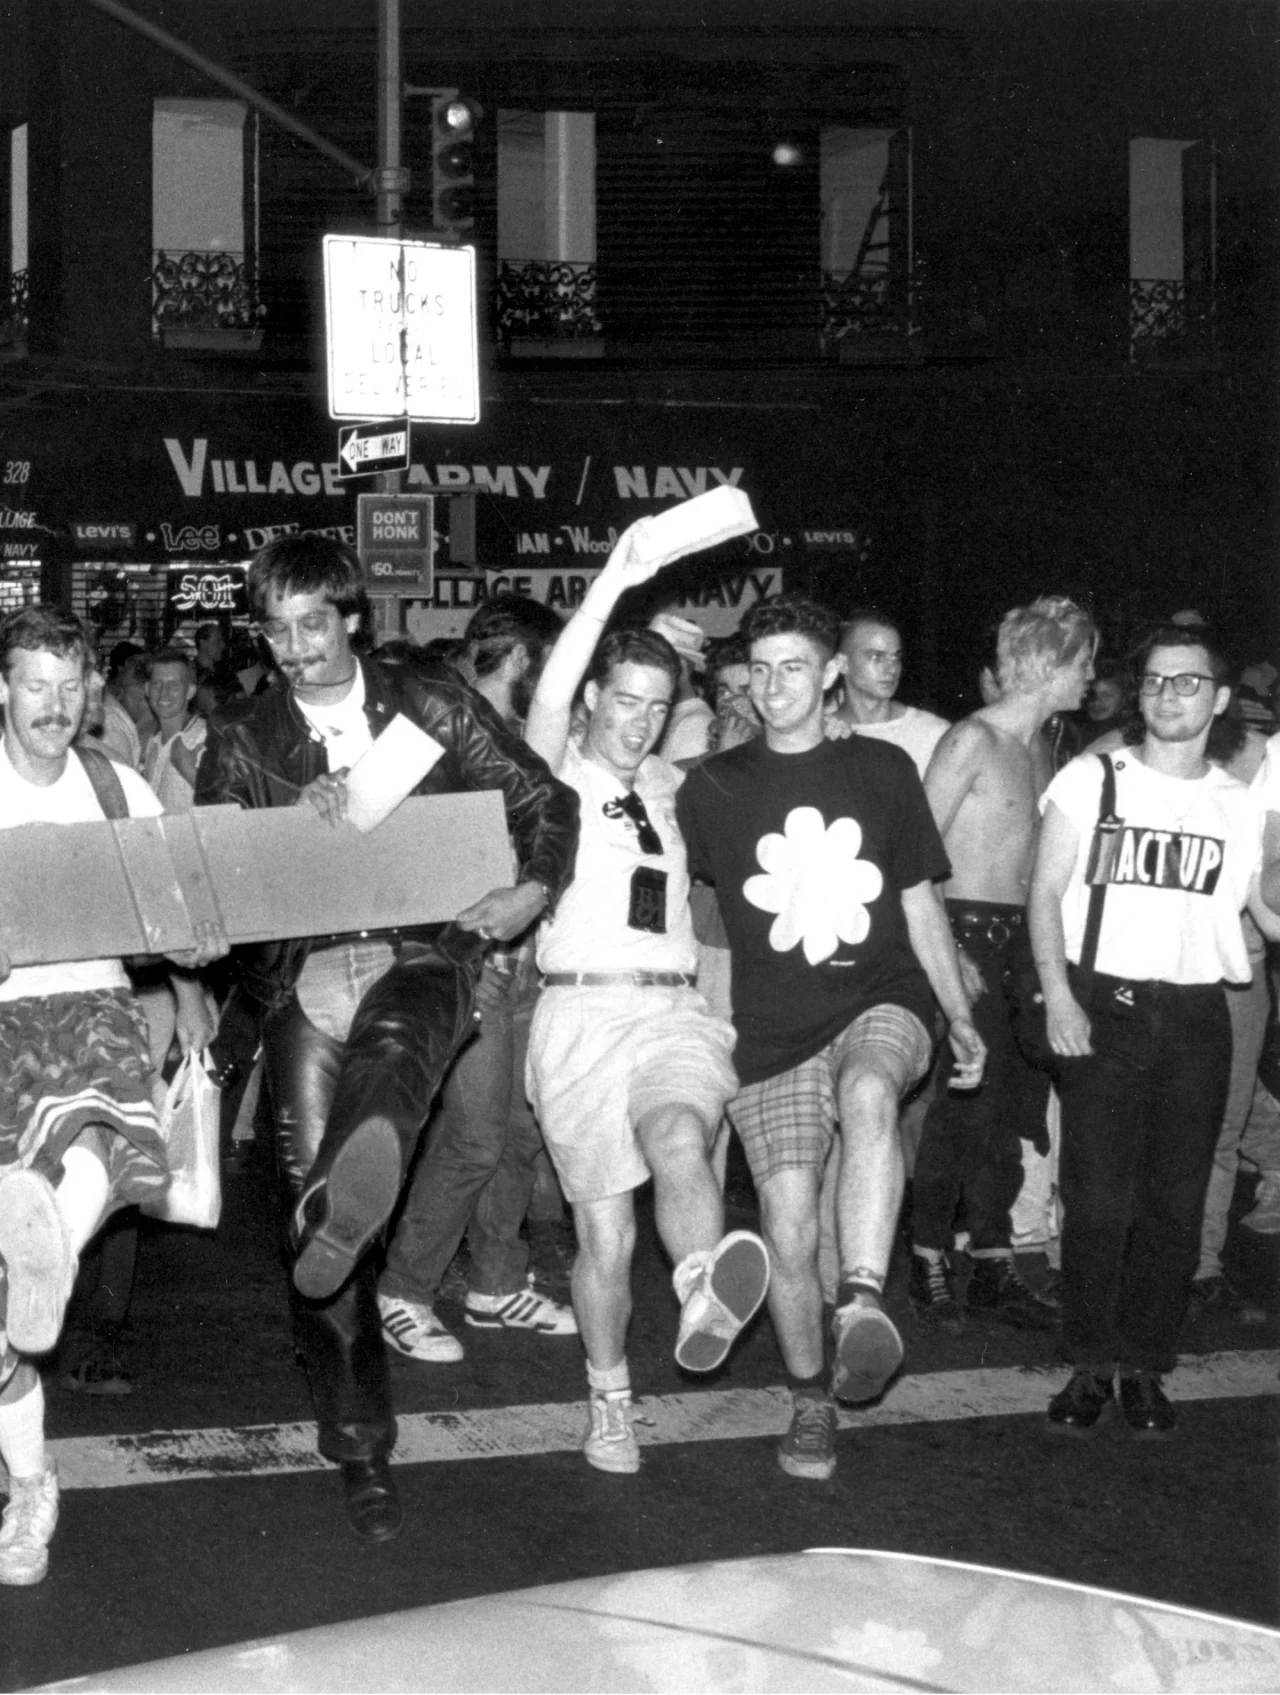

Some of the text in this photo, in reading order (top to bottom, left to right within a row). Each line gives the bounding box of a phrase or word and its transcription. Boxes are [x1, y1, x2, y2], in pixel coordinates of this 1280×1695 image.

[390, 260, 417, 281] NO
[359, 289, 444, 316] TRUCKS
[372, 341, 437, 367] LOAL
[349, 435, 402, 460] ONE WAY
[3, 461, 31, 484] 328
[164, 438, 346, 497] VILLAGE
[407, 464, 551, 498] ARMY
[373, 511, 418, 524] DON'T
[160, 523, 220, 552] Lee
[373, 526, 418, 540] HONK
[174, 575, 240, 611] 501
[1116, 829, 1222, 891] ACT UP
